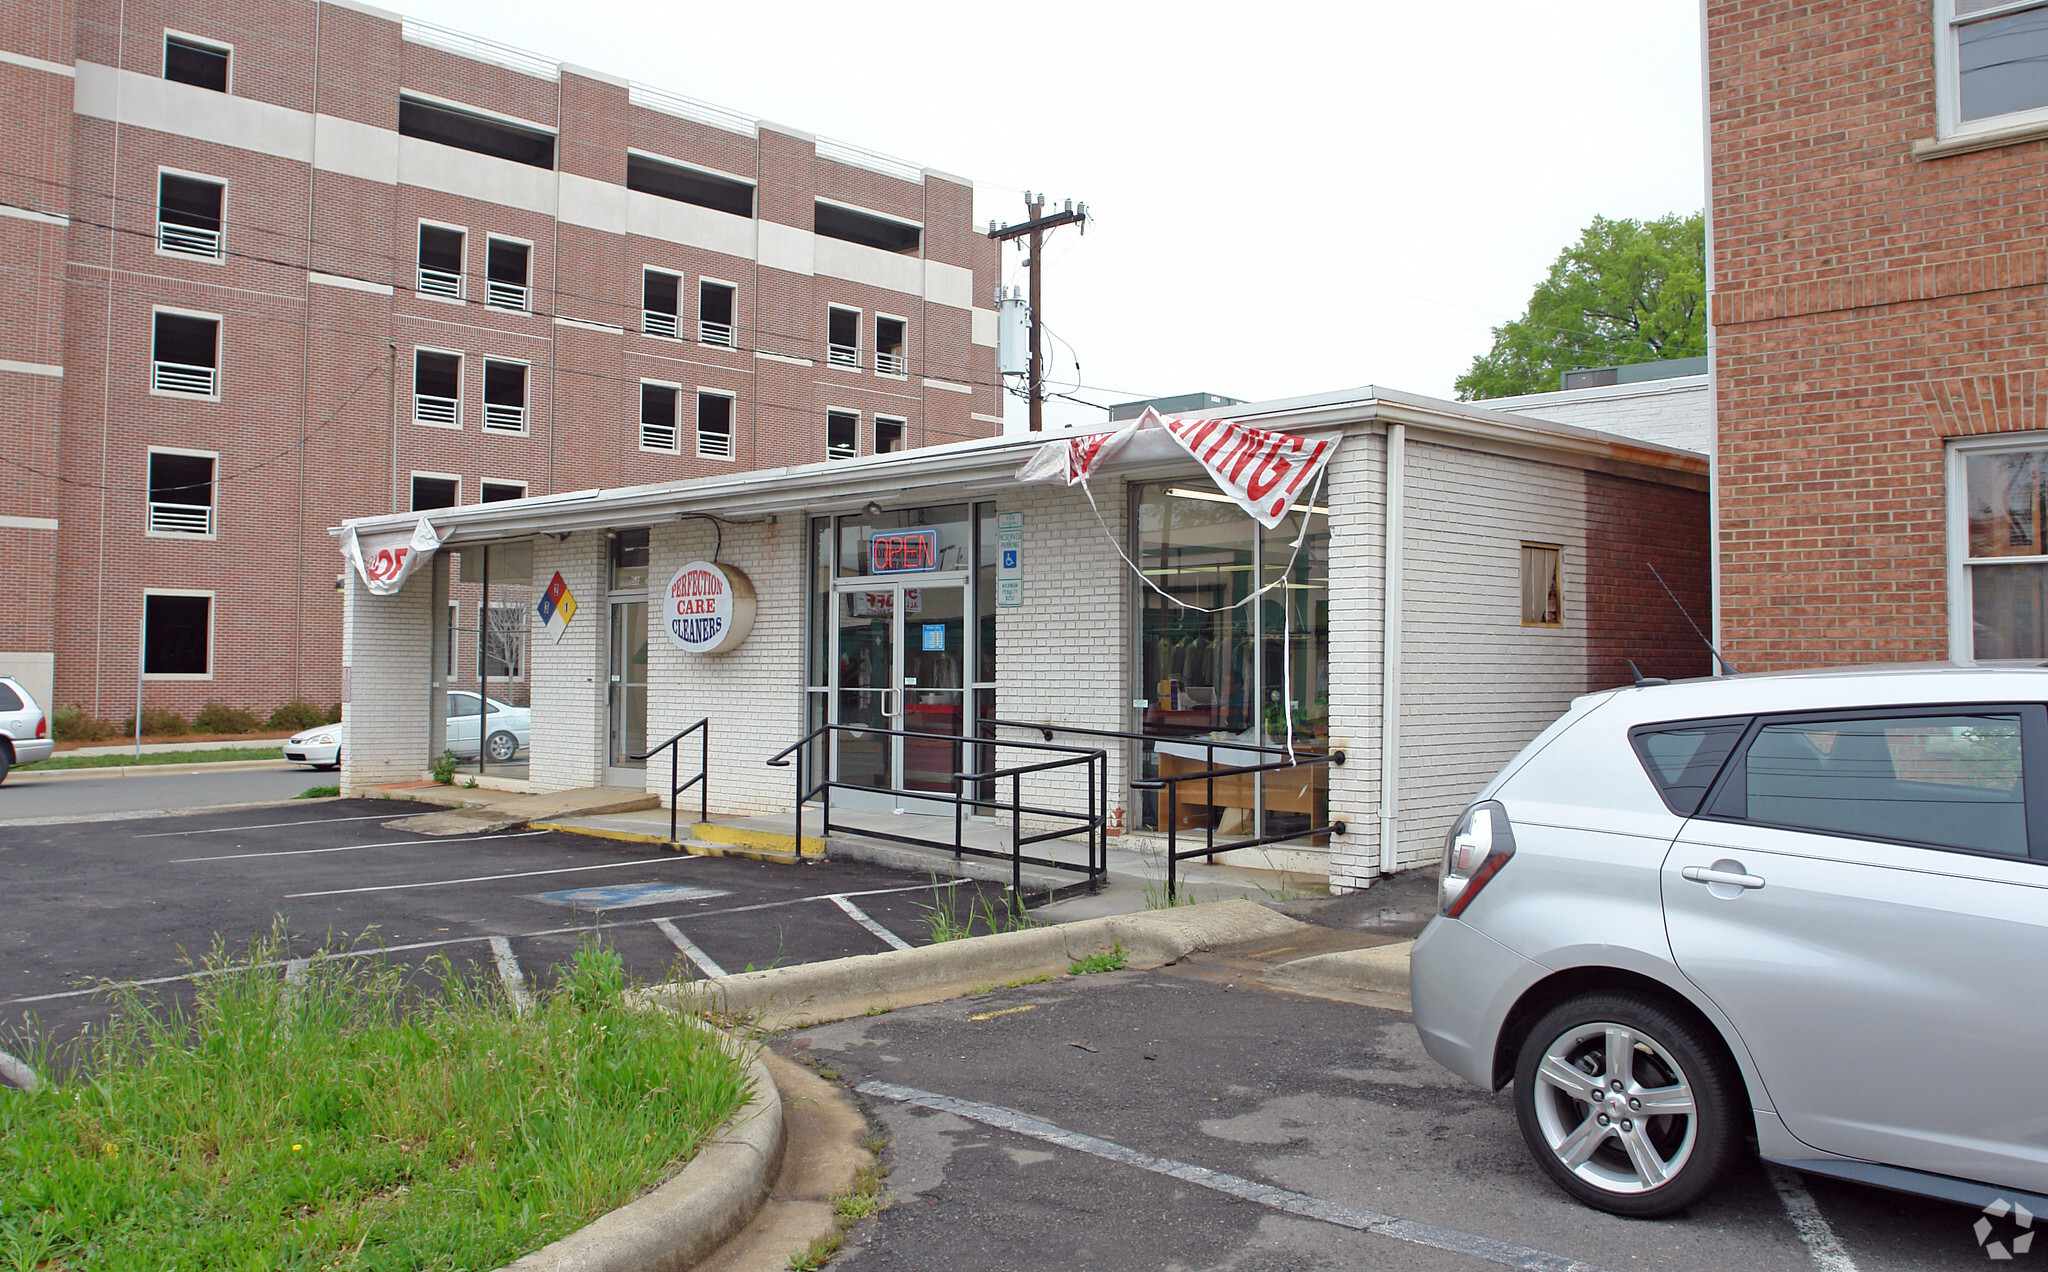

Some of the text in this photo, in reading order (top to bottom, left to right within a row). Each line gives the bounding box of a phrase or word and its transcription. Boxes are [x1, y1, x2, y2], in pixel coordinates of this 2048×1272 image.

[1169, 418, 1328, 517] NING!
[874, 534, 934, 569] OPEN
[1001, 541, 1019, 549] PARKING
[554, 584, 559, 595] 2
[671, 569, 723, 598] PERFECTION
[677, 598, 716, 615] CARE
[672, 617, 722, 643] CLEANERS
